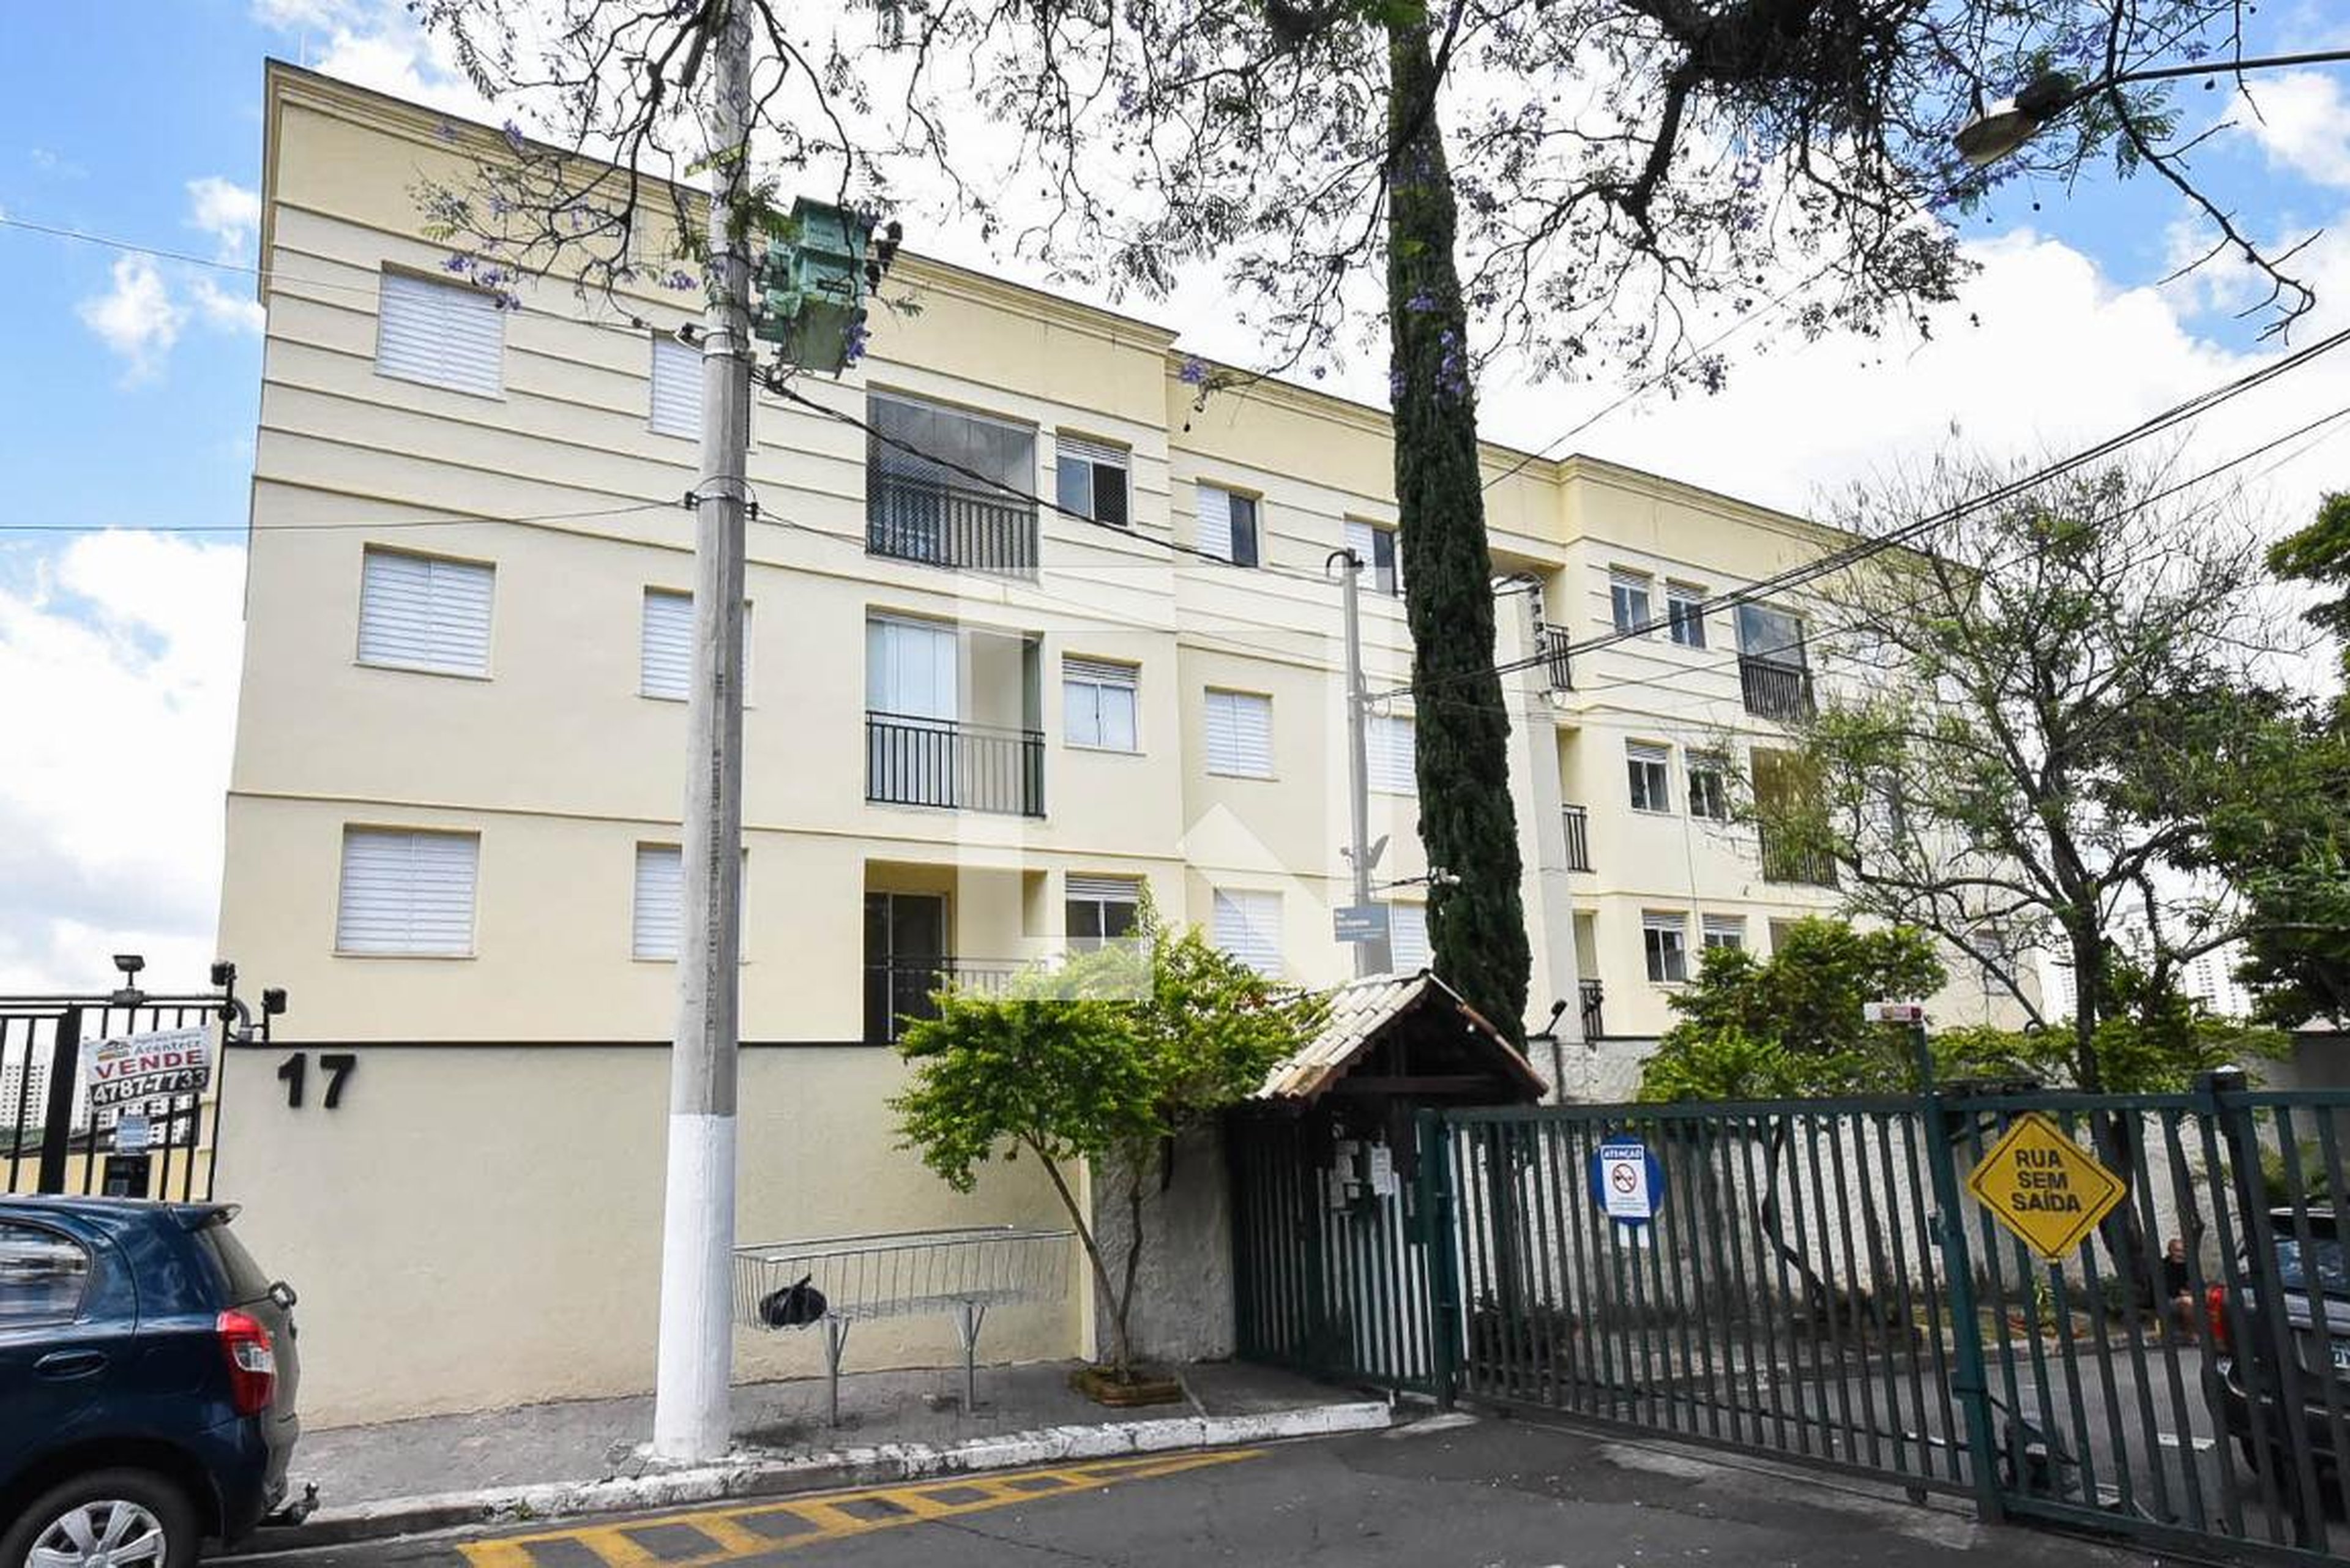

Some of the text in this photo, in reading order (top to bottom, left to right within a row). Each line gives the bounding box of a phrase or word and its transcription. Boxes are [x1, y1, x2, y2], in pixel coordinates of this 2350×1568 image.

[95, 1049, 203, 1079] VENDE
[94, 1069, 206, 1103] 4787-7733
[278, 1053, 356, 1108] 17
[2015, 1149, 2062, 1167] RUA
[2017, 1171, 2068, 1189] SEM
[2012, 1190, 2081, 1212] SAÍDA
